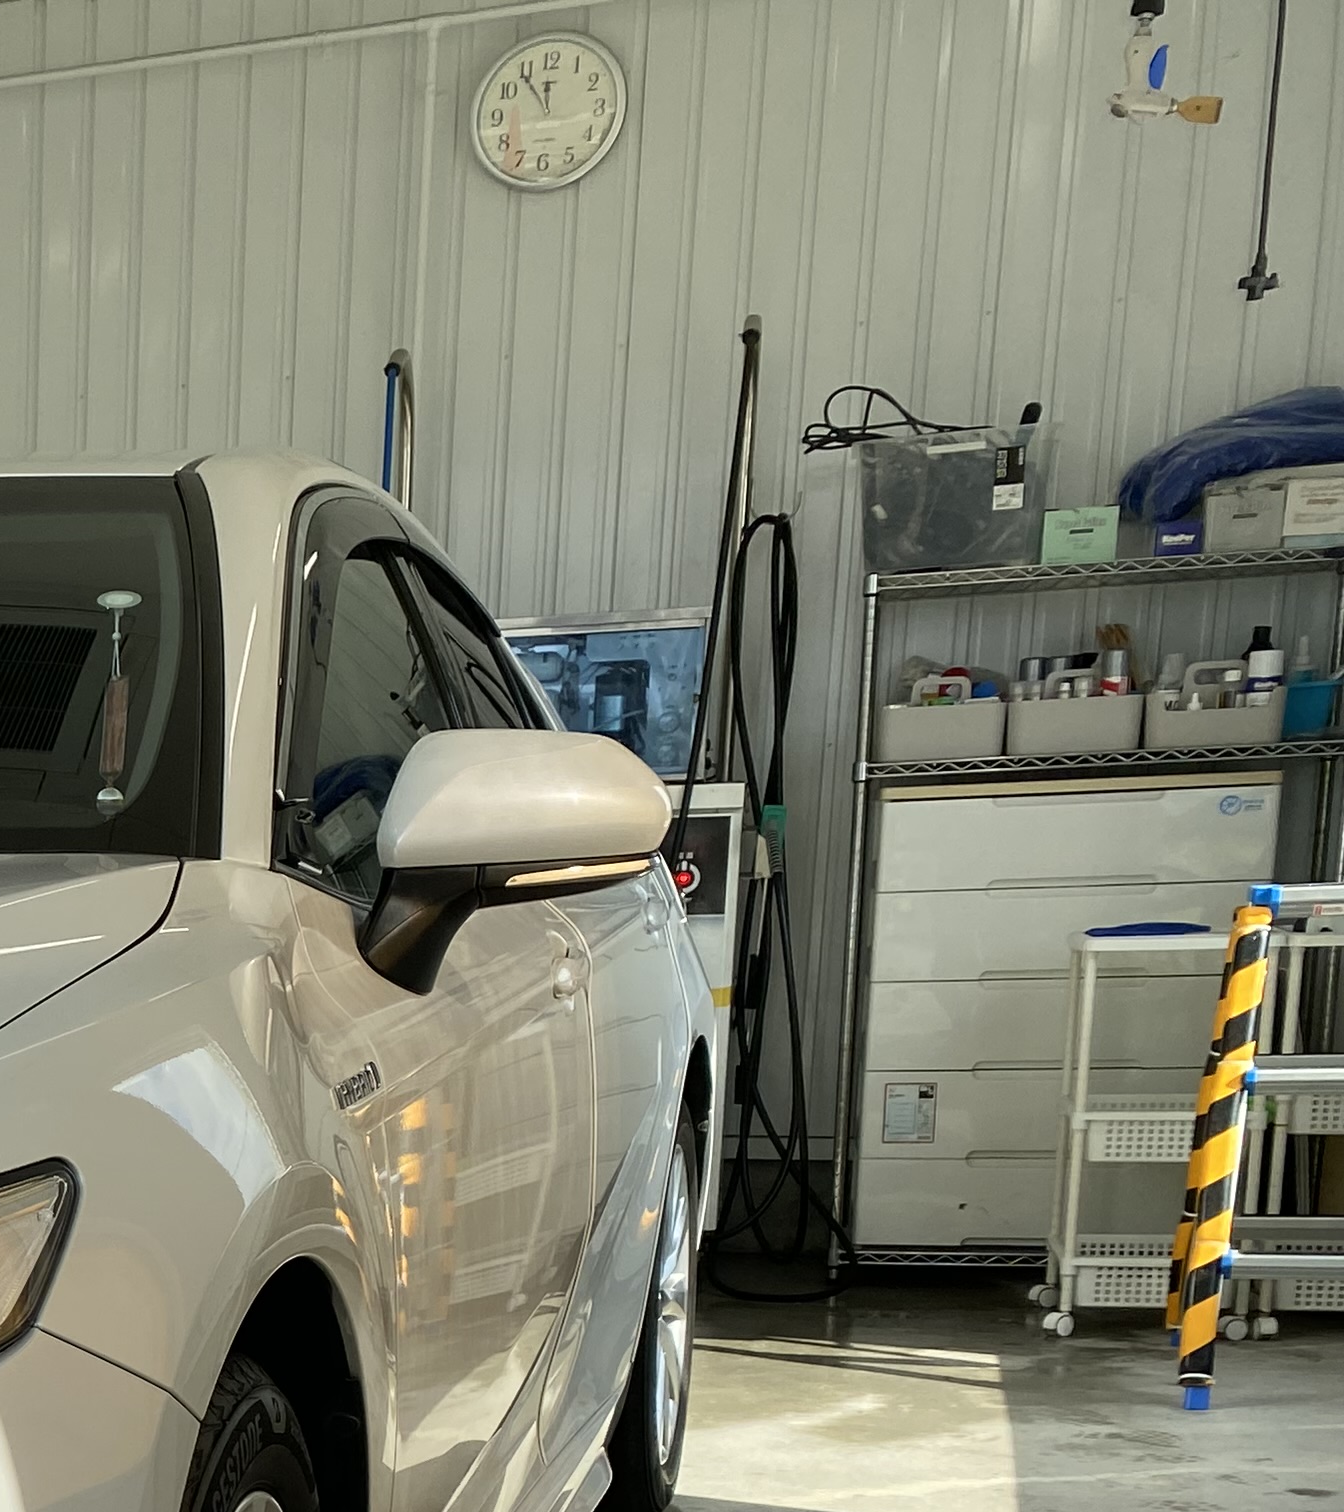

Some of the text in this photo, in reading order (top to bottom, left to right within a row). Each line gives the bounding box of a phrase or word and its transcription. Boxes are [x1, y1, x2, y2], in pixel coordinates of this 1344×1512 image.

[520, 60, 533, 79] 11
[543, 51, 561, 71] 12
[573, 55, 580, 74] 1
[500, 81, 518, 100] 10
[587, 72, 599, 92] 2
[593, 98, 606, 117] 3
[491, 108, 503, 127] 9
[498, 133, 510, 151] 8
[583, 125, 593, 142] 4
[514, 150, 526, 169] 7
[536, 153, 549, 171] 6
[563, 146, 575, 164] 5
